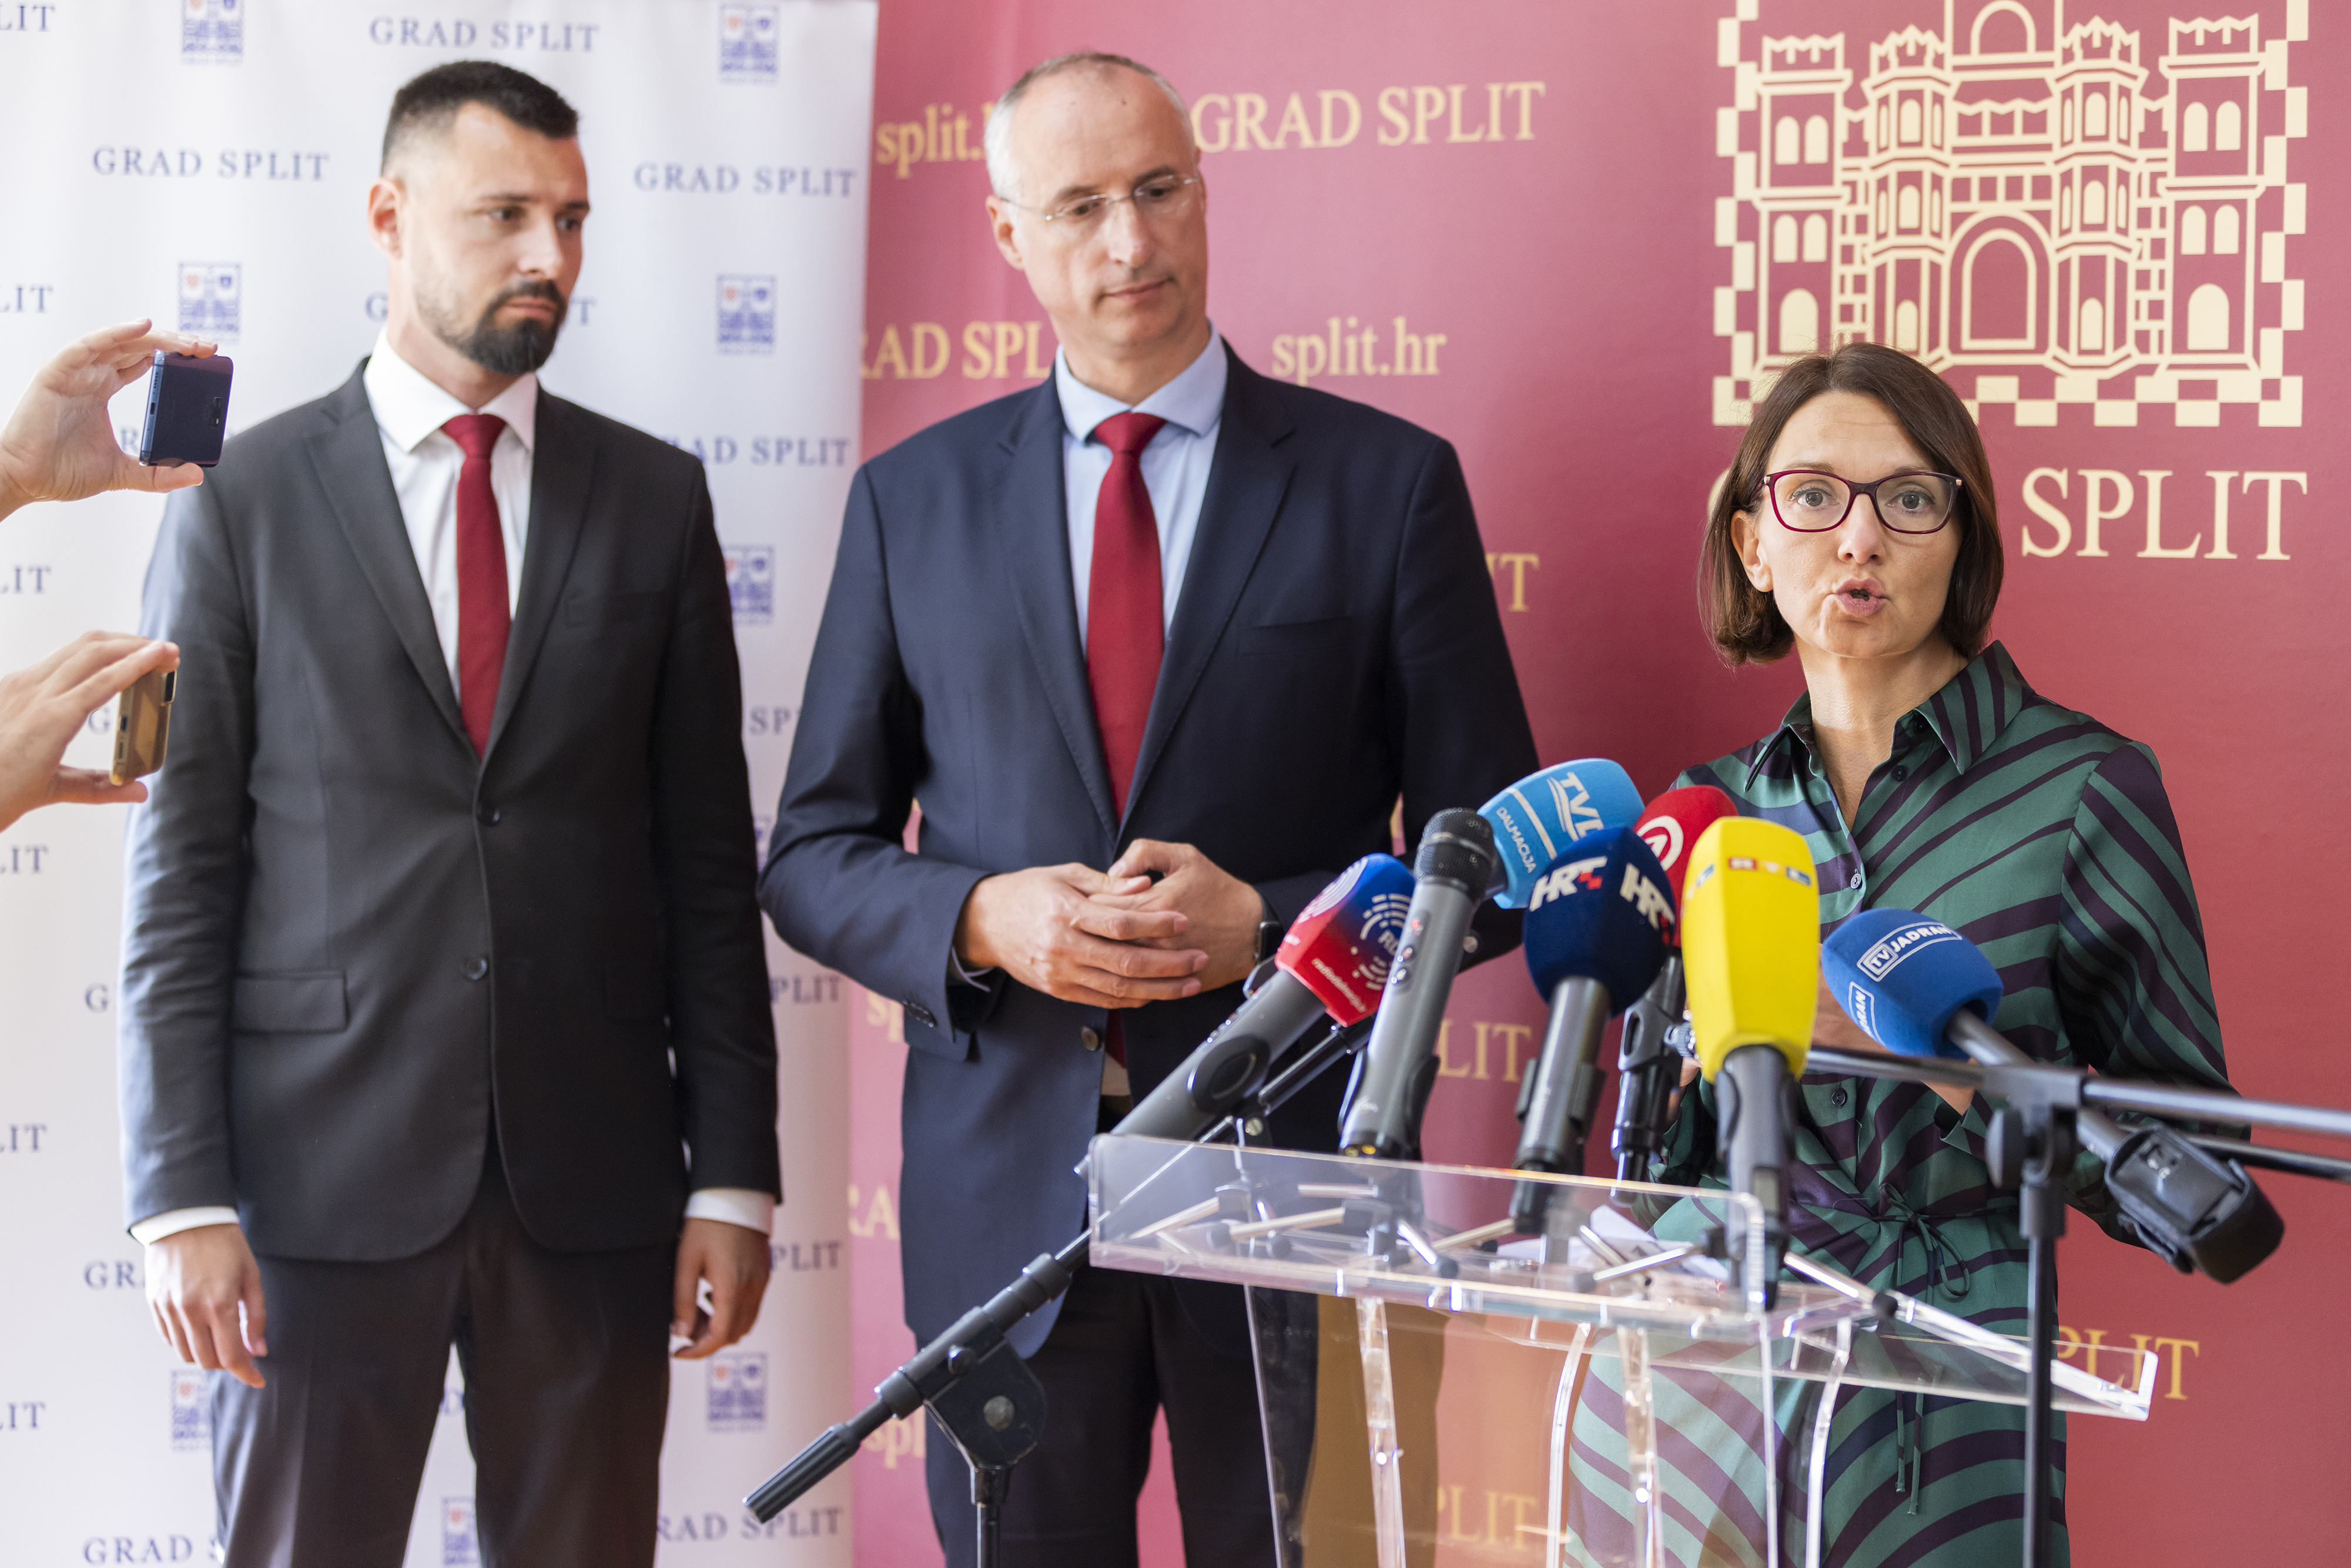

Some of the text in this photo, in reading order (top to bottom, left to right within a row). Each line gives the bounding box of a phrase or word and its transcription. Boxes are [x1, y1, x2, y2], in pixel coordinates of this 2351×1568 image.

[369, 16, 600, 52] GRAD SPLIT
[1191, 81, 1545, 153] GRAD SPLIT
[876, 102, 995, 179] split.
[92, 146, 330, 181] GRAD SPLIT
[633, 162, 858, 197] GRAD SPLIT
[1271, 316, 1447, 386] split.hr
[751, 437, 850, 467] SPLIT
[2021, 465, 2308, 561] SPLIT
[1496, 807, 1536, 874] DALMACIJA
[1870, 949, 1890, 968] TV
[83, 1534, 192, 1564] GRAD
